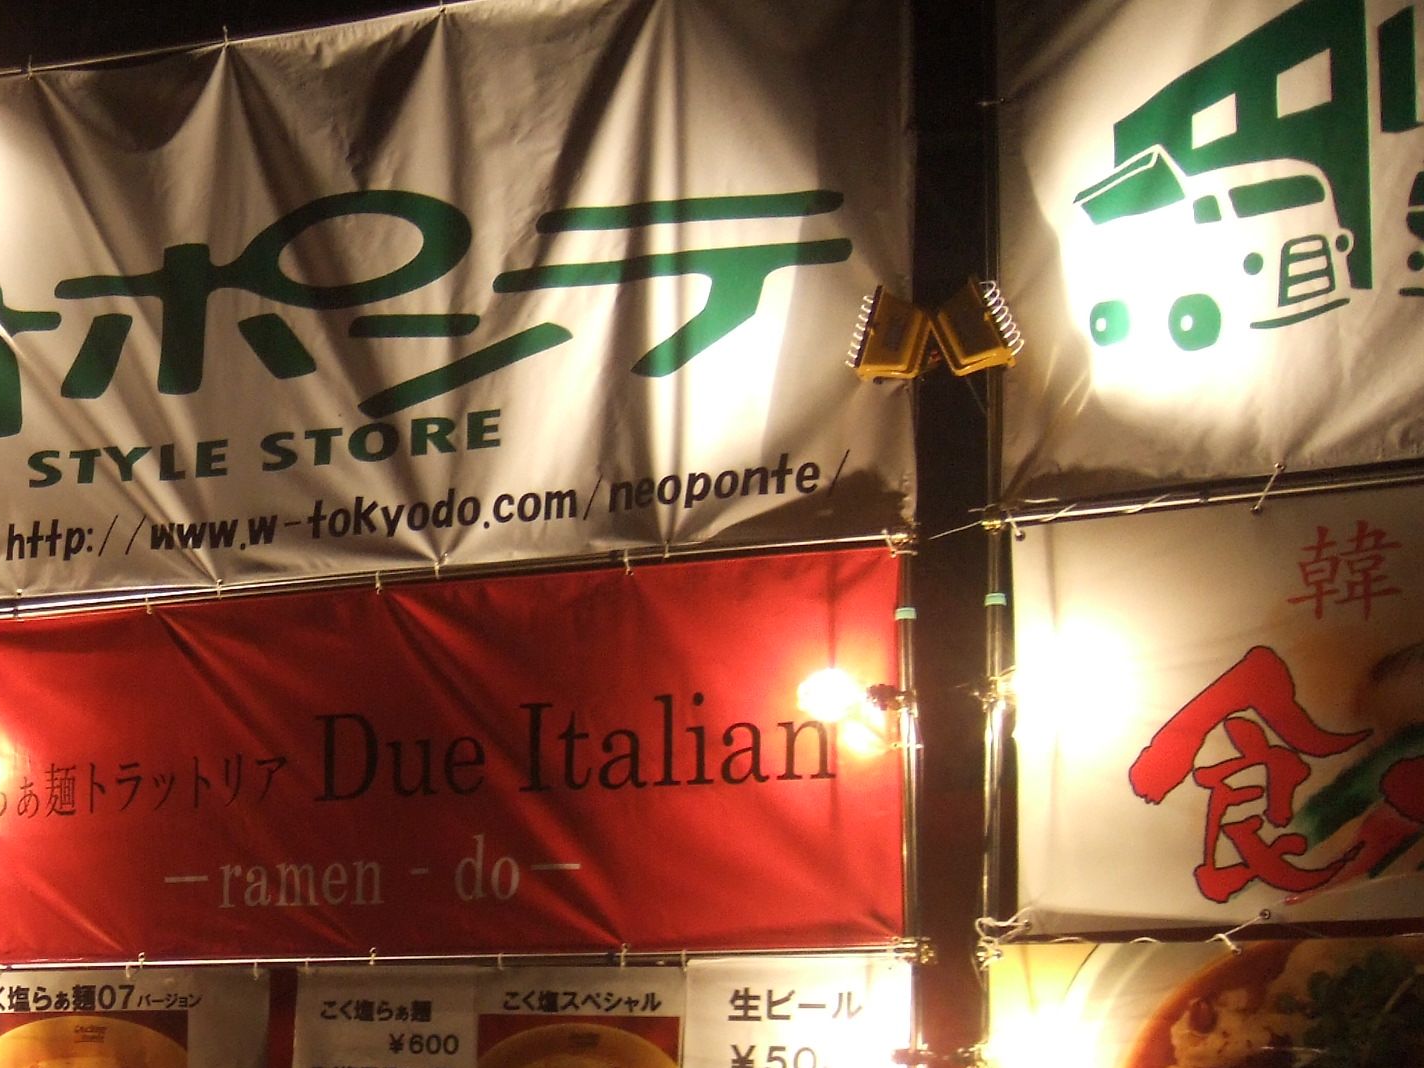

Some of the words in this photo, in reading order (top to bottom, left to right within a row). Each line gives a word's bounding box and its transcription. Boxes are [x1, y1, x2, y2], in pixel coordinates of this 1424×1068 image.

[28, 438, 228, 488] STYLE
[261, 408, 503, 474] STORE
[6, 449, 850, 561] http://www.w-tokyodo.com/neoponte/
[1287, 519, 1403, 621] 韓
[314, 711, 486, 802] Due
[518, 691, 837, 791] Italian
[1129, 645, 1424, 905] 食
[389, 1033, 460, 1055] ¥600
[503, 991, 662, 1014] こく塩スペシャル
[728, 987, 862, 1022] 生ビール
